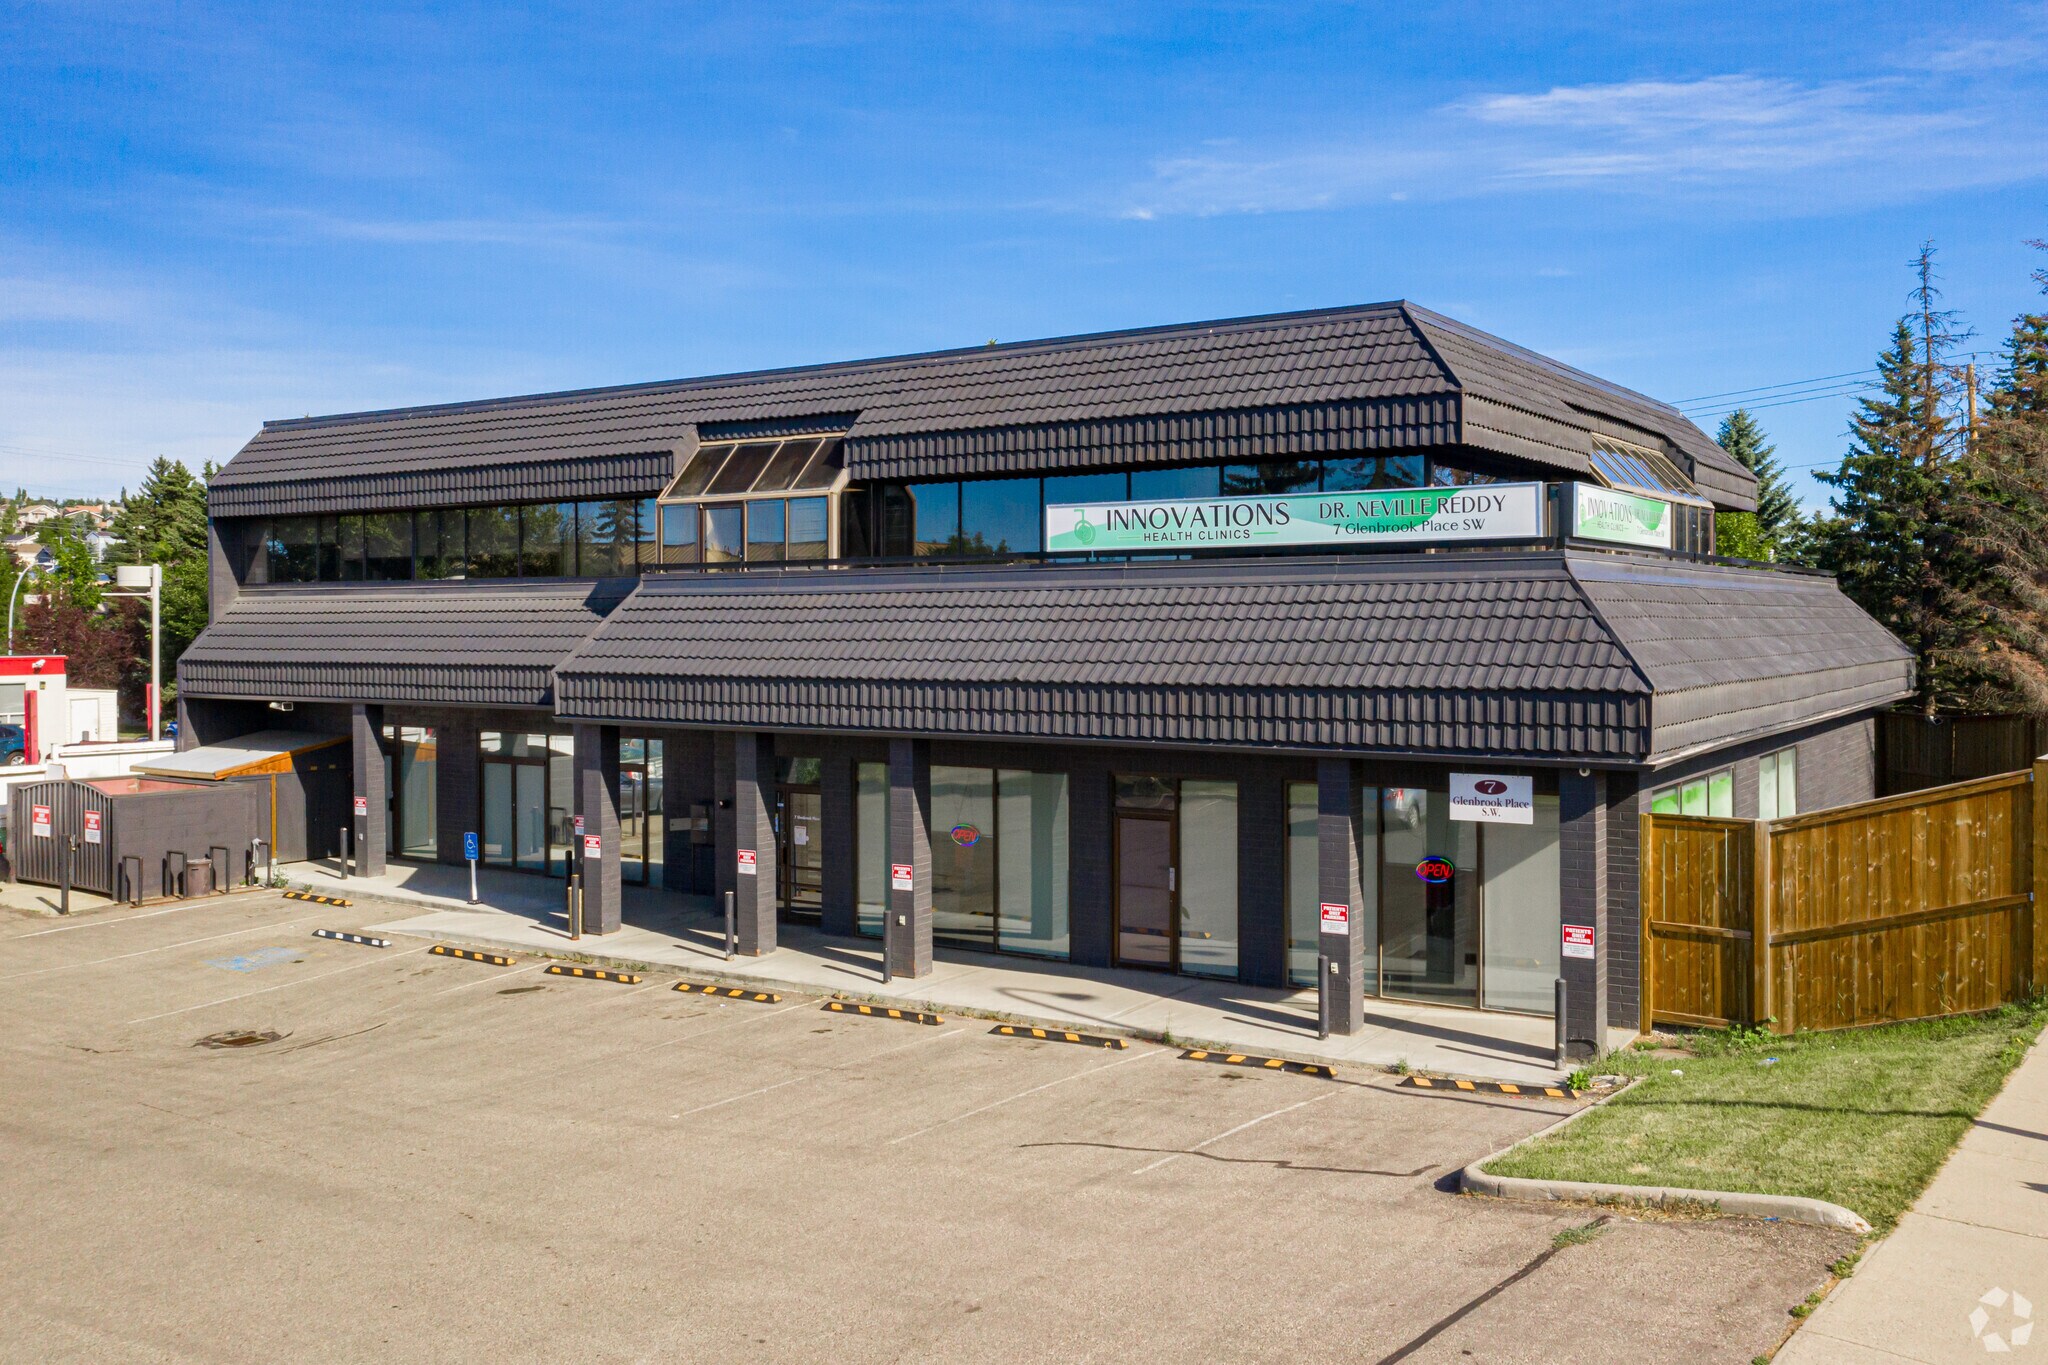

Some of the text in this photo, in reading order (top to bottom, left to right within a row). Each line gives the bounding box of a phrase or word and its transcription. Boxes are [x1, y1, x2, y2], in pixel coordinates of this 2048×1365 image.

[1319, 495, 1506, 519] DR. NEVILLE REDDY
[1587, 497, 1632, 524] INNOVATIONS
[1106, 501, 1290, 531] INNOVATIONS
[1333, 518, 1486, 535] 7 Glenbrook Place SW
[1143, 529, 1250, 542] HEALTH CLINICS
[1484, 781, 1496, 793] 7
[1452, 796, 1530, 809] Glenbrook Place
[1481, 808, 1501, 817] S.W.
[952, 829, 977, 842] OPEN
[1417, 863, 1450, 877] OPEN
